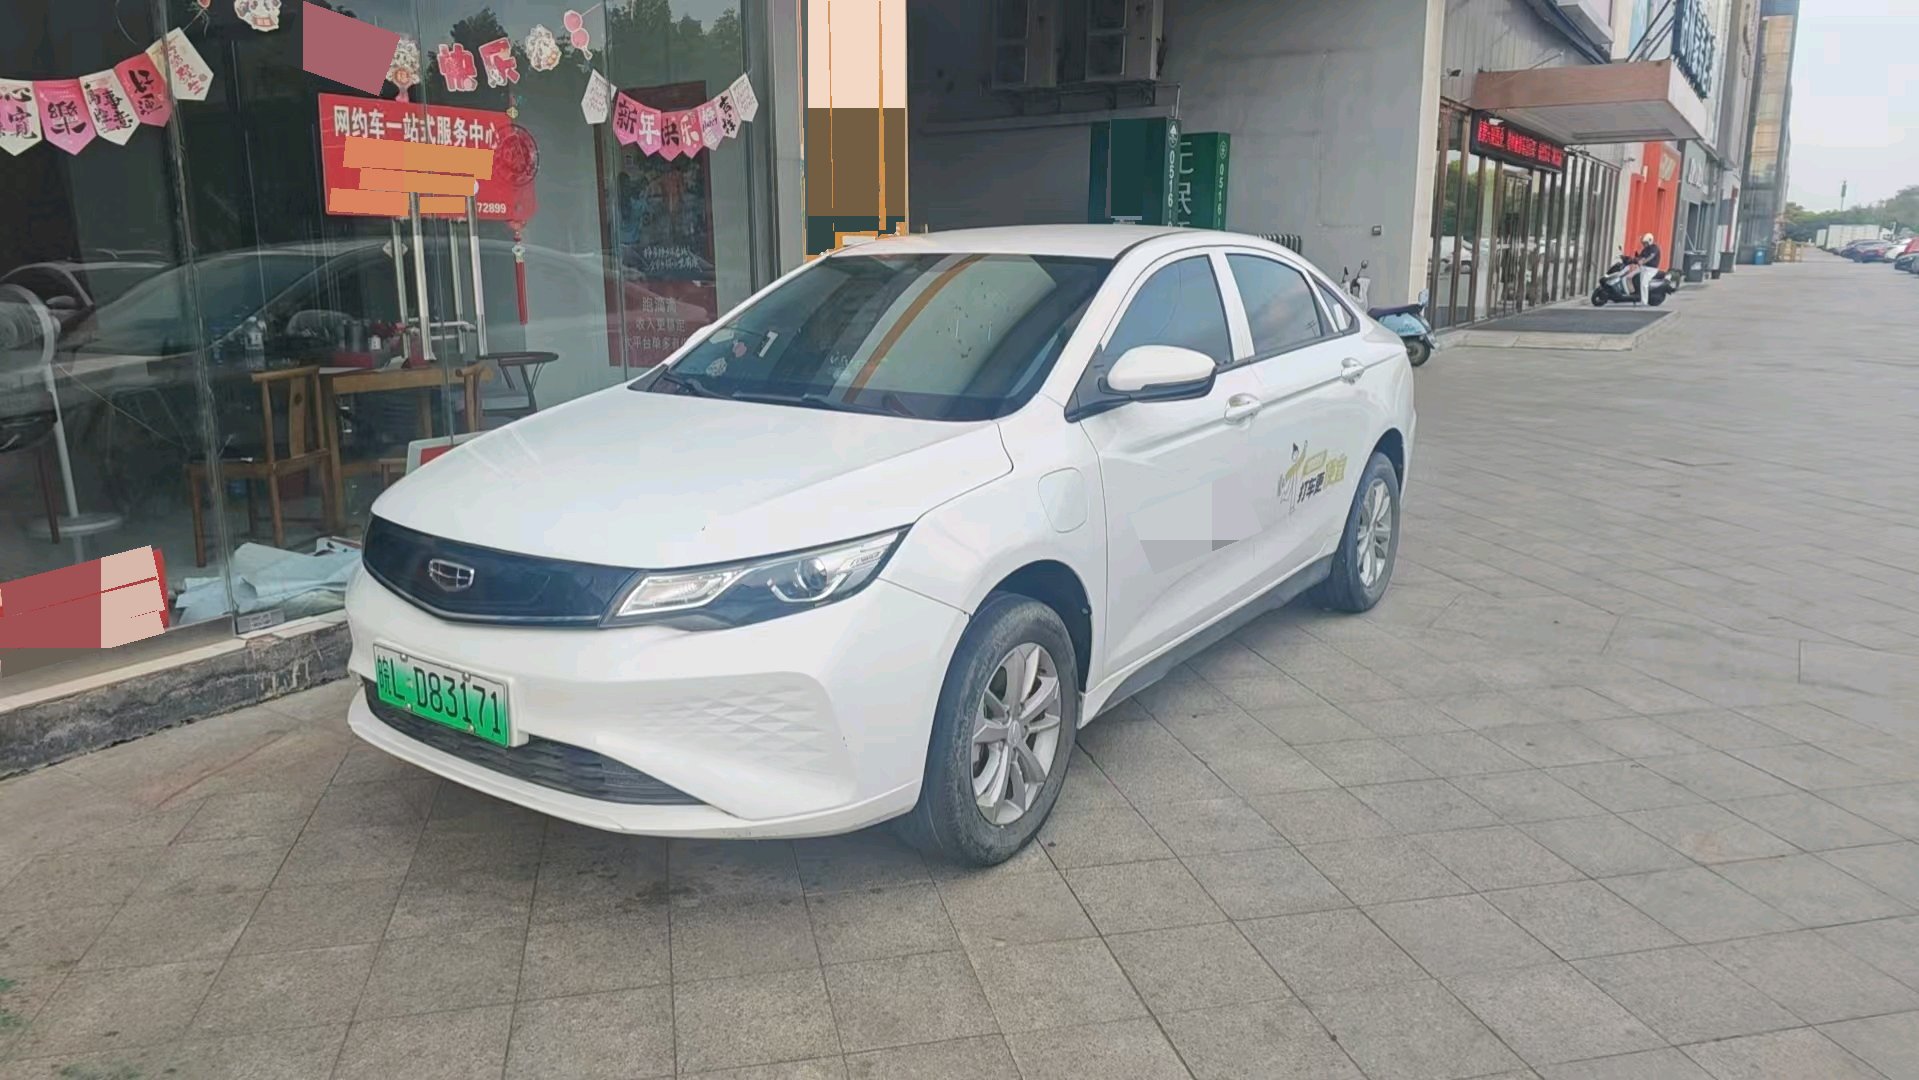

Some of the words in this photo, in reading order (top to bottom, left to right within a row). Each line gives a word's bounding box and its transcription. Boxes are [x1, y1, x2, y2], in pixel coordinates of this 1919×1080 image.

[333, 104, 500, 149] 网约车一站式服务中心
[641, 296, 677, 313] 跑滴滴
